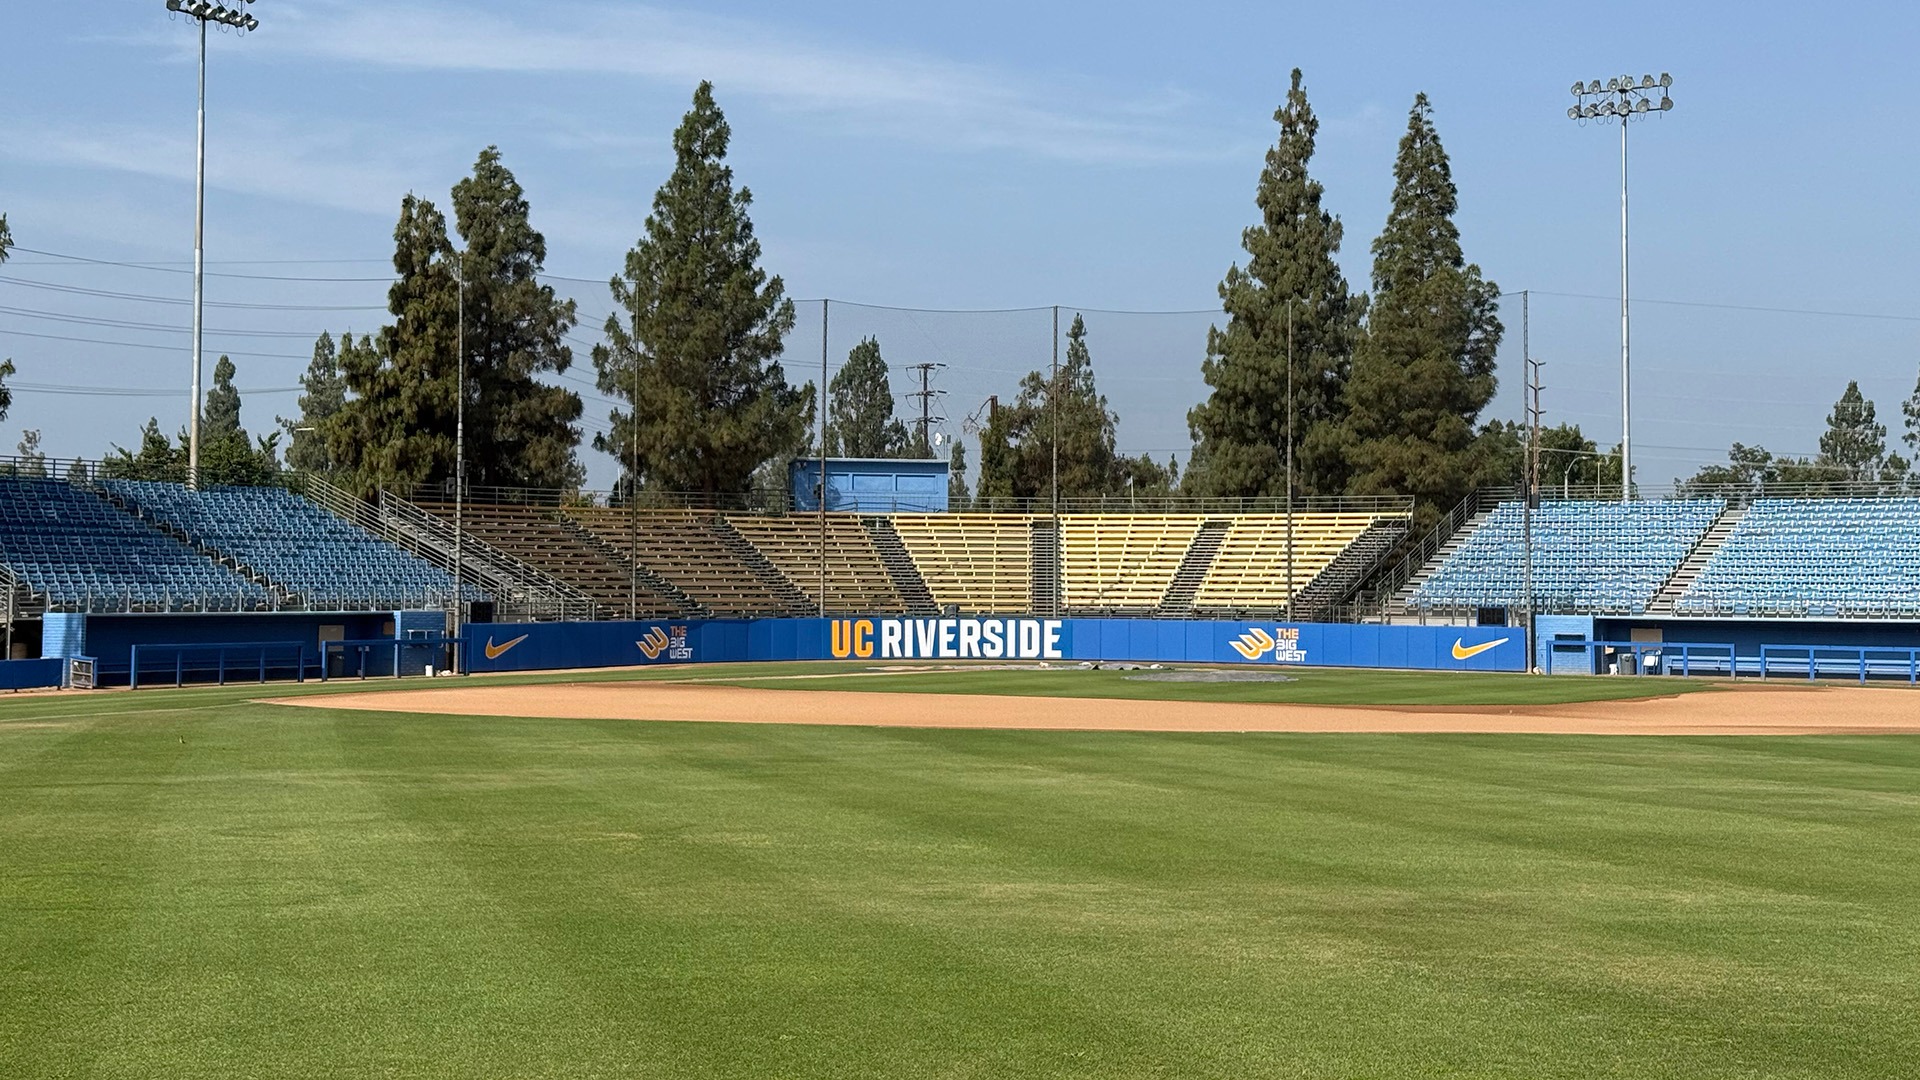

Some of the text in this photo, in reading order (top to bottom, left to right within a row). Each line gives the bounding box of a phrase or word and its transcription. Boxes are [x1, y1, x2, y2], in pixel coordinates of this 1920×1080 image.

[670, 625, 687, 637] THE
[1276, 628, 1299, 639] THE
[670, 637, 685, 648] BIG
[831, 619, 1062, 658] UC RIVERSIDE
[1276, 639, 1297, 650] BIG
[669, 648, 693, 659] WEST
[1275, 650, 1307, 662] WEST
